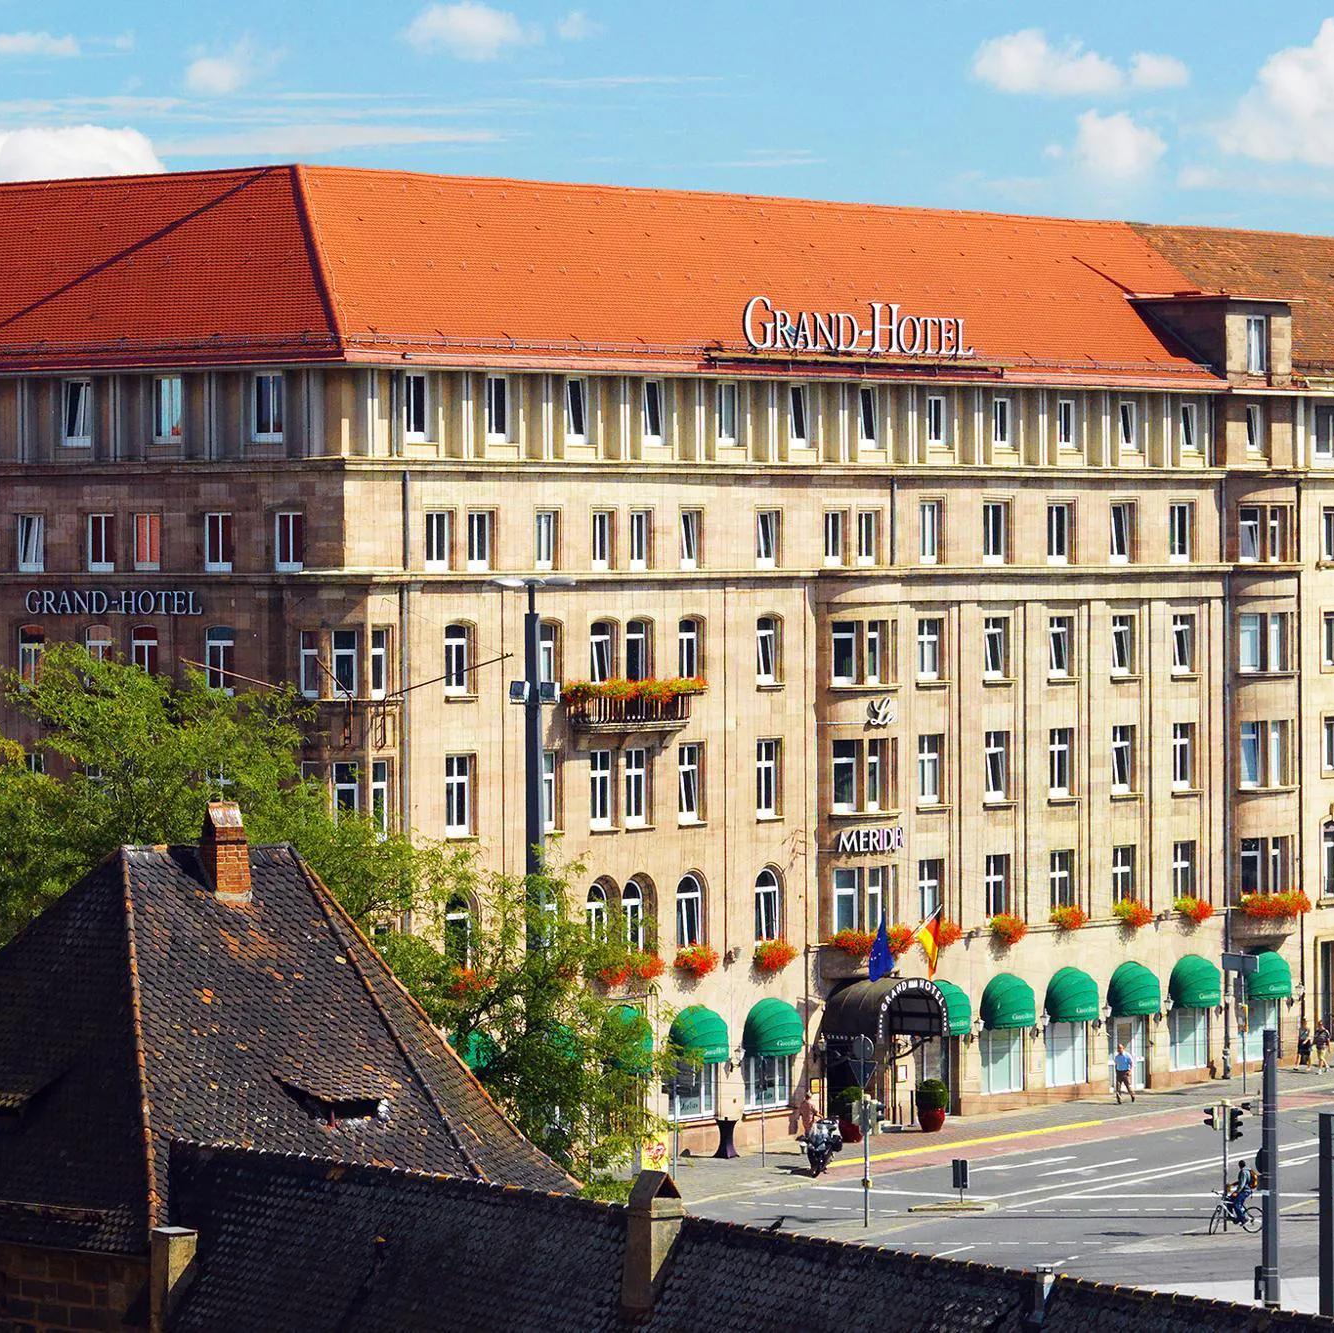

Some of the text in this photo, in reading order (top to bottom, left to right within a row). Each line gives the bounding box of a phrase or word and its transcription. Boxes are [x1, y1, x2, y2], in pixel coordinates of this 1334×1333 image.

[743, 296, 973, 355] GRAND-HOTEL
[25, 589, 203, 615] GRAND-HOTEL
[870, 697, 896, 726] Le
[881, 980, 944, 1011] GRAND HOTEL
